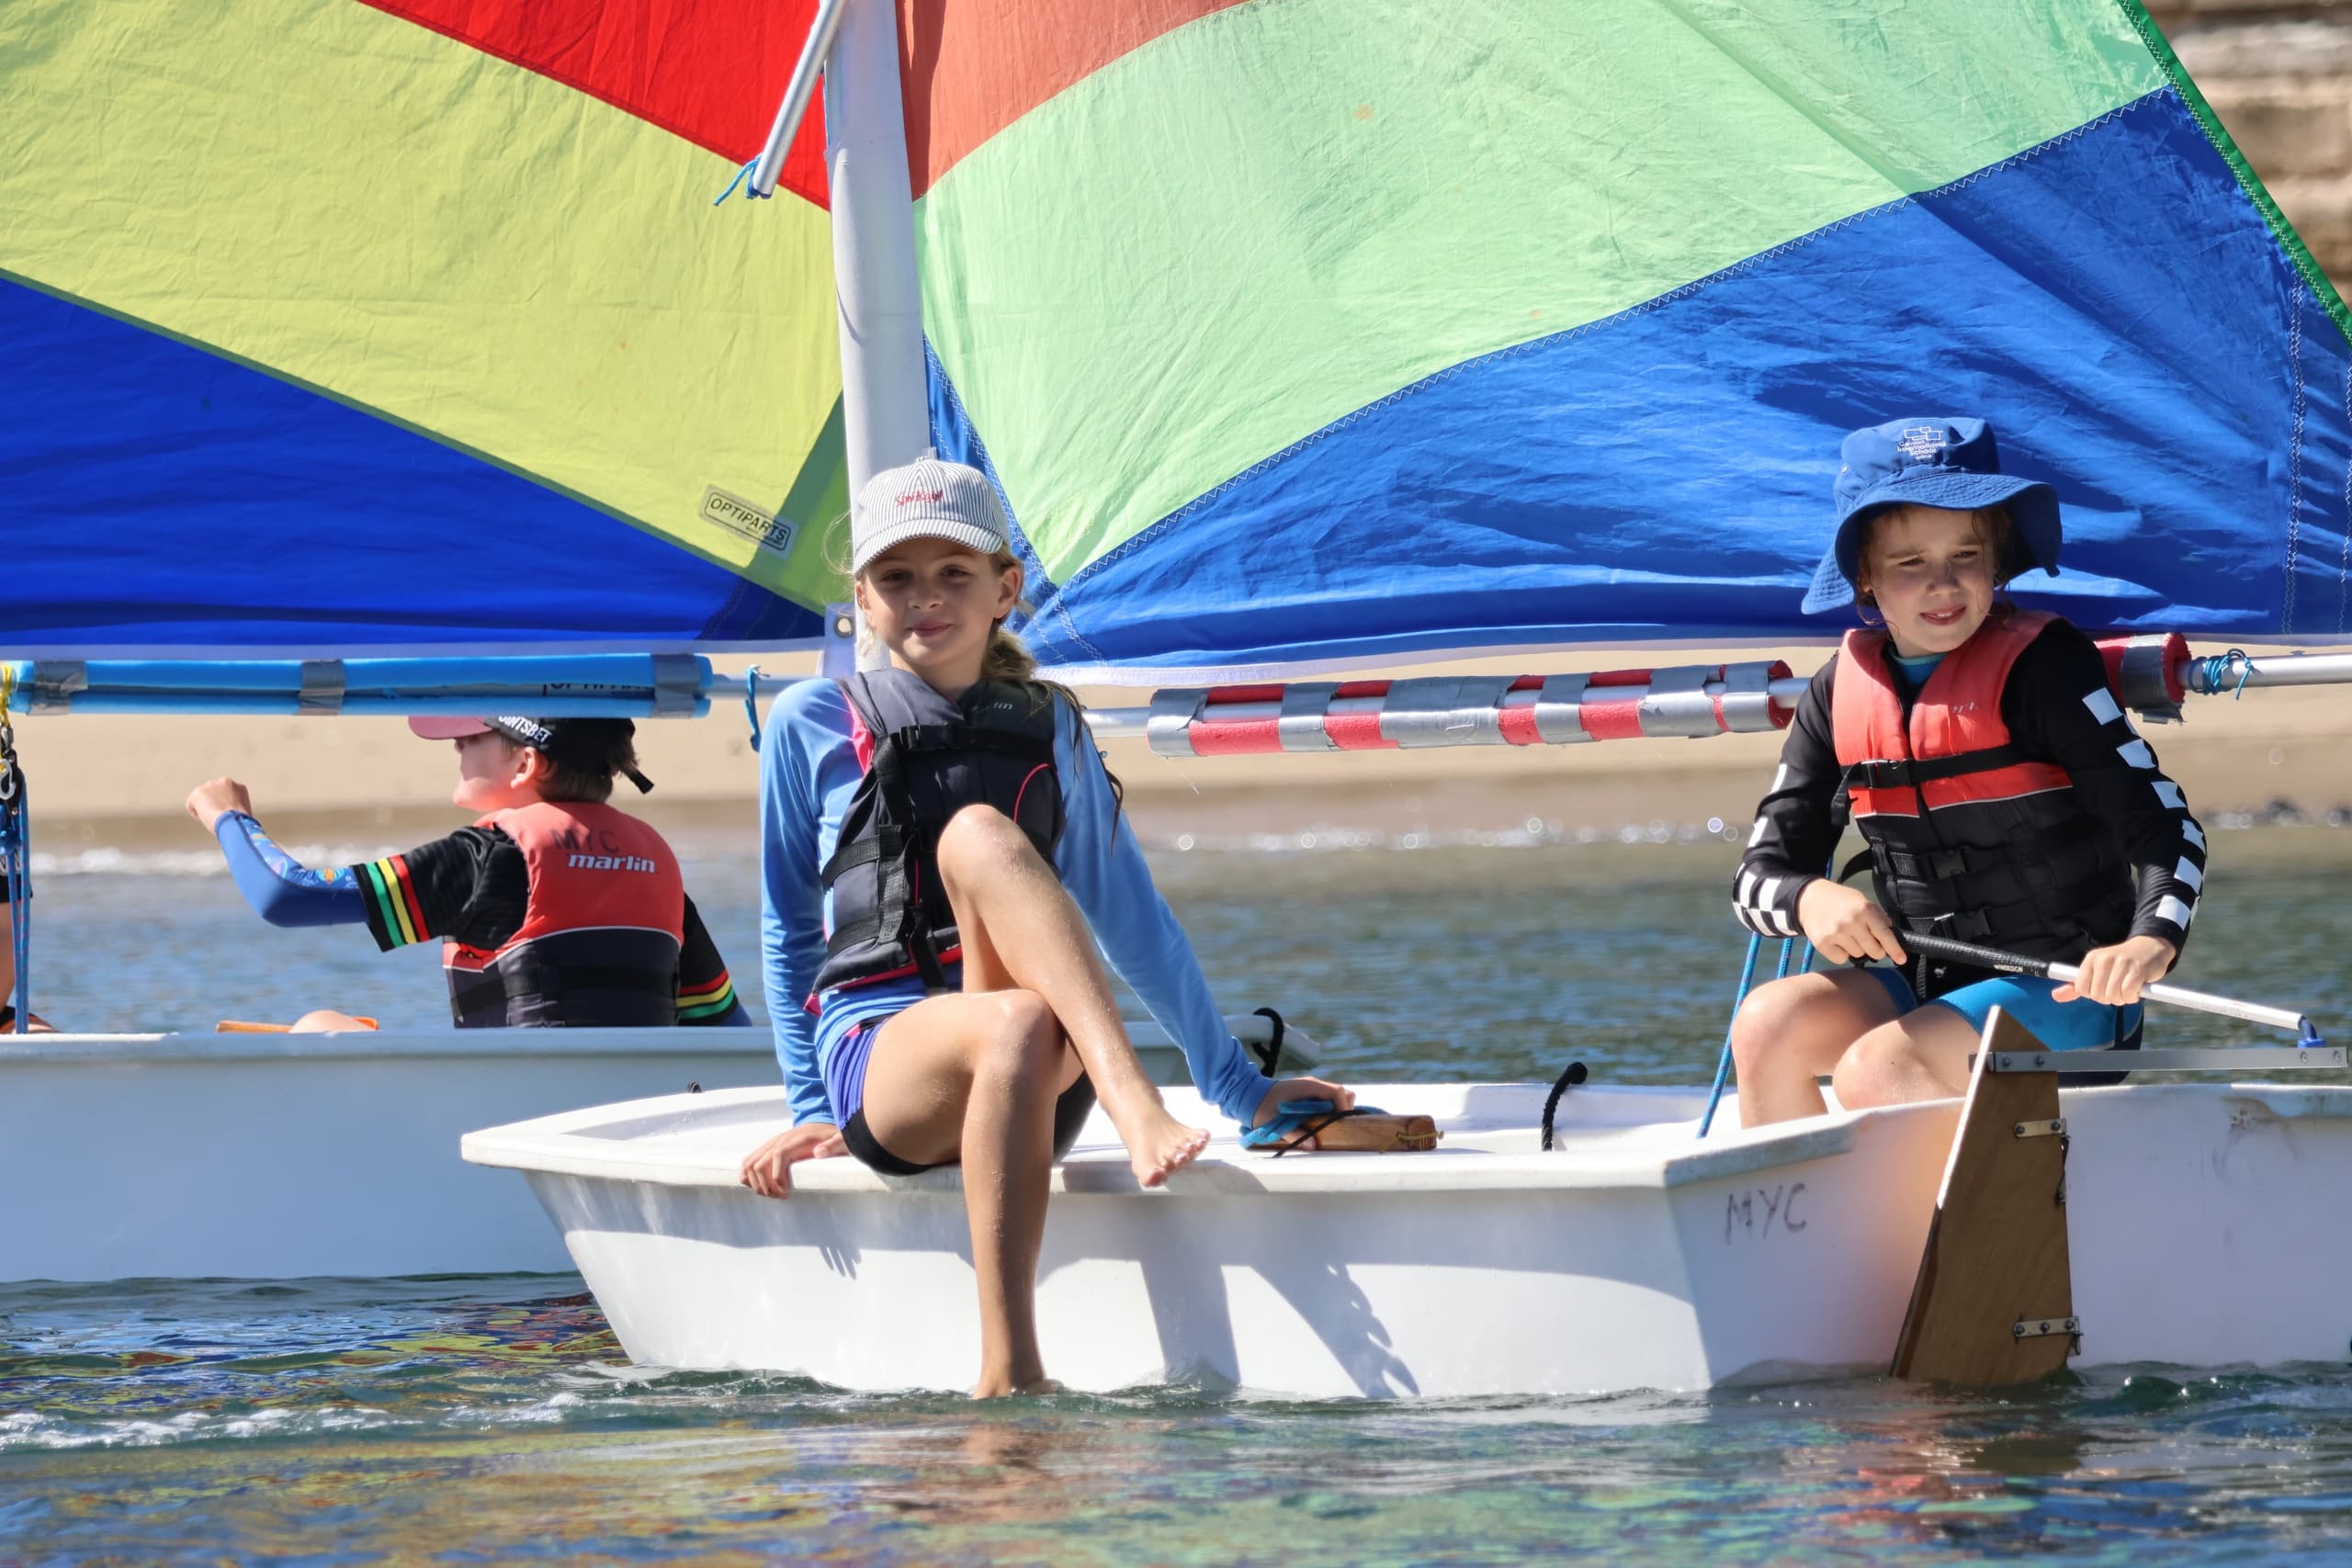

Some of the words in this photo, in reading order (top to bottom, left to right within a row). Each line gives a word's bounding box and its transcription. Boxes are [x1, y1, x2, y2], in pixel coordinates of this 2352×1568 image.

[710, 498, 788, 542] OPTIPARTS
[568, 853, 656, 874] marlin
[1725, 1182, 1807, 1246] MYC
